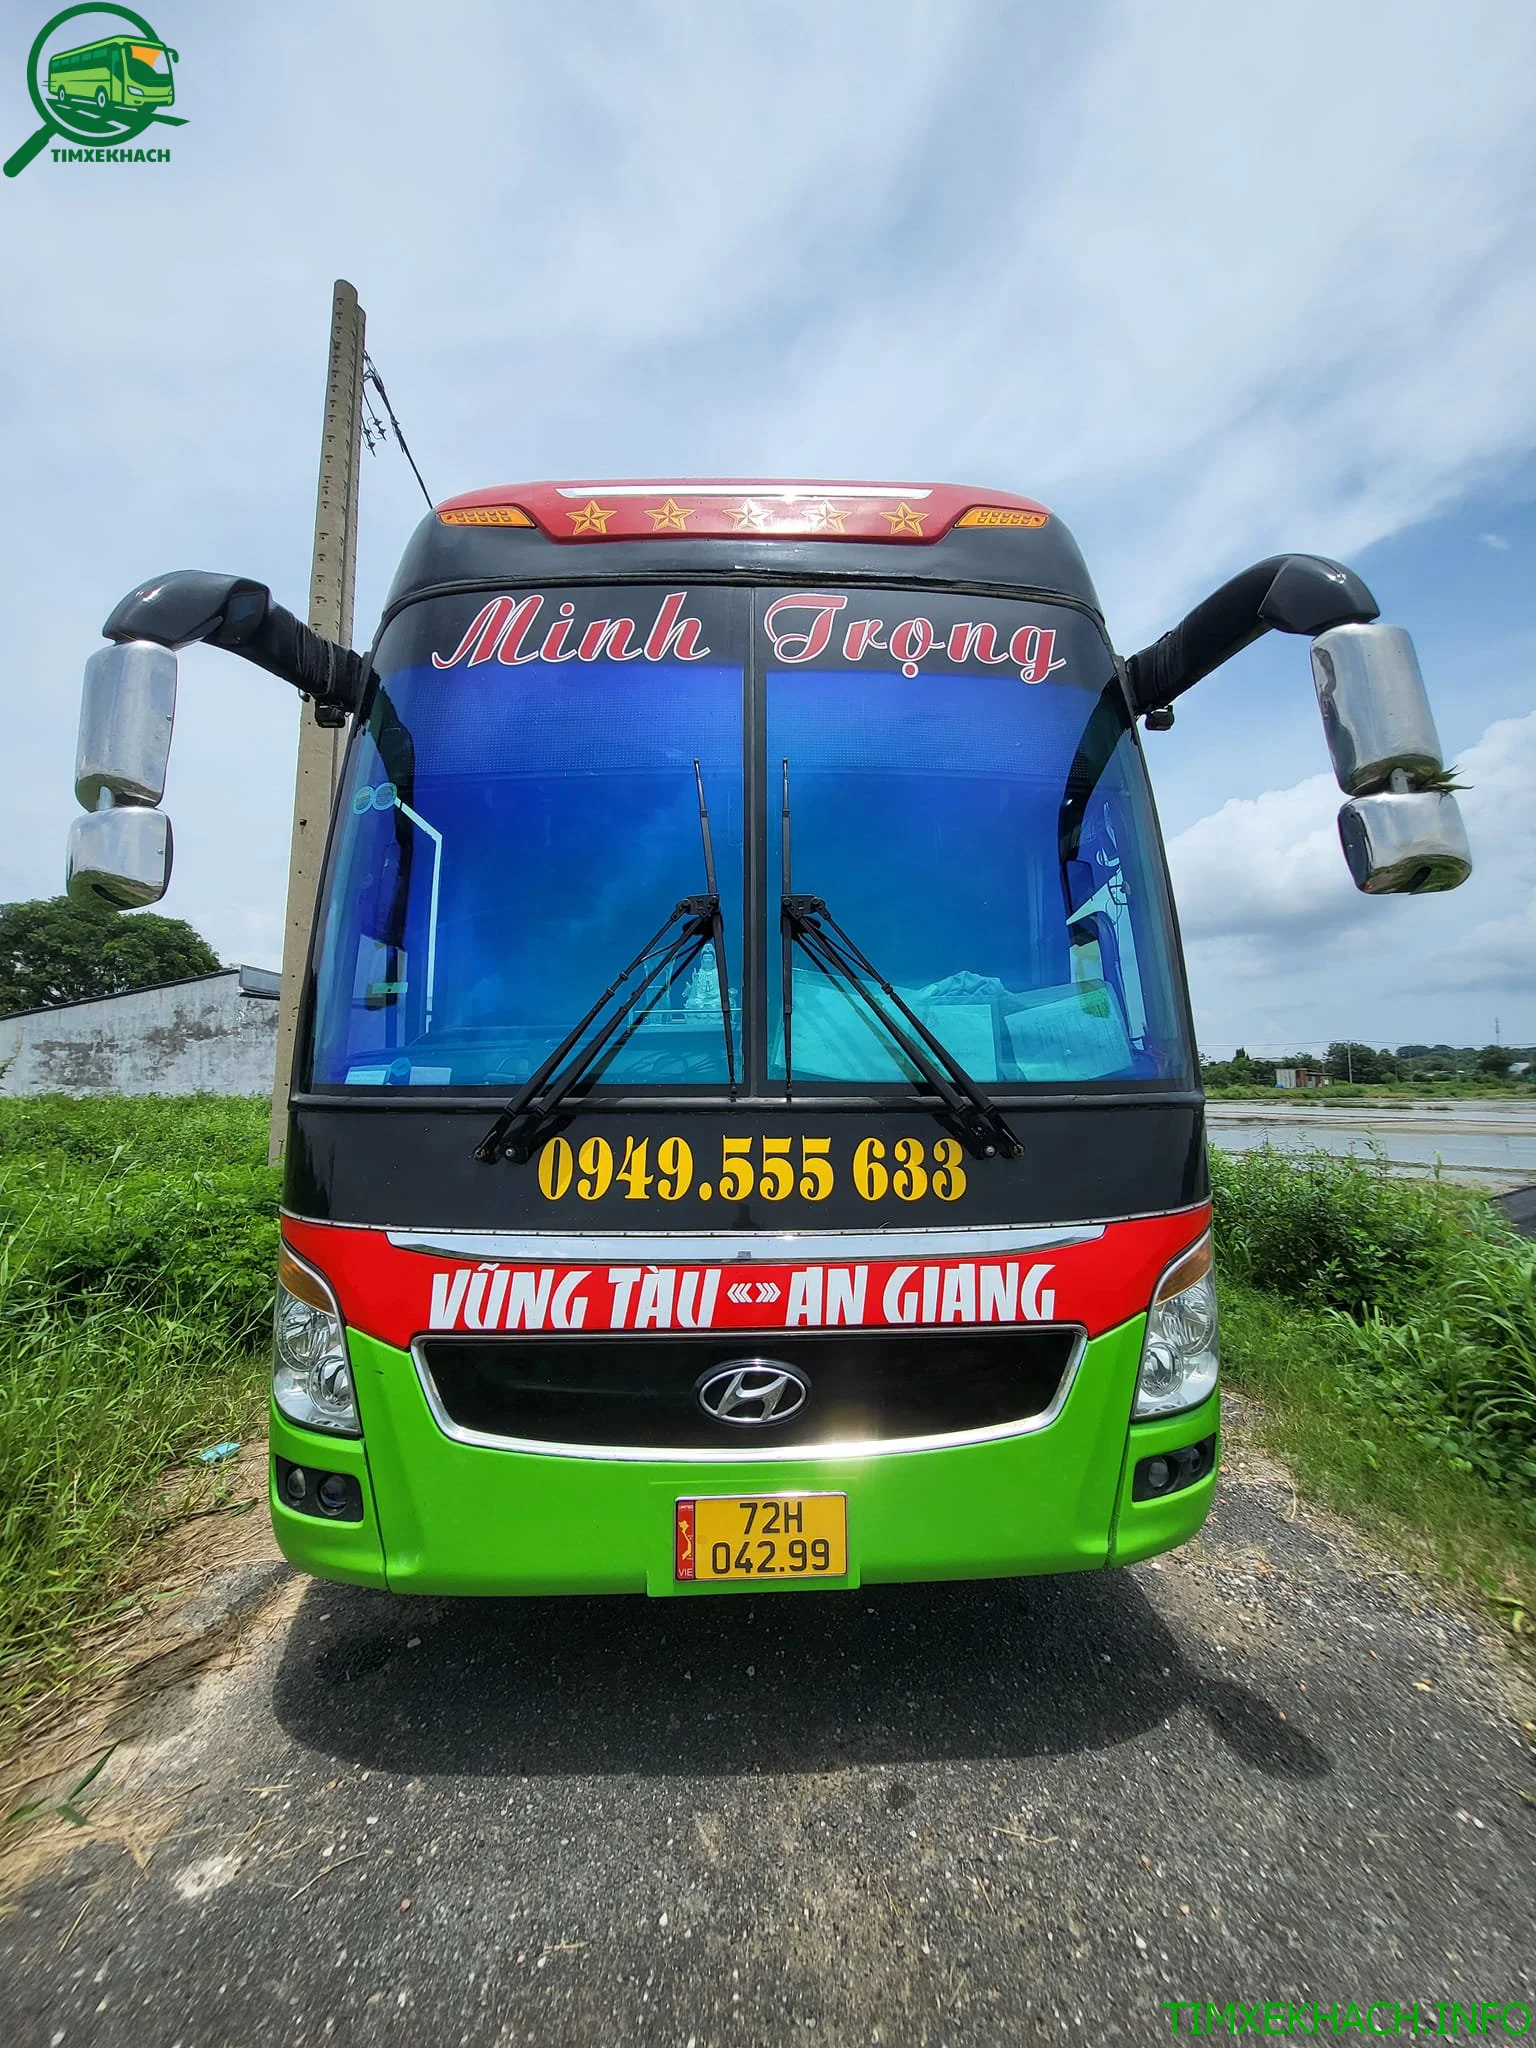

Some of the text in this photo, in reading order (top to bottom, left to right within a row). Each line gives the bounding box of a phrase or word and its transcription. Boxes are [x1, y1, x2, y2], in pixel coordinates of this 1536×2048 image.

[431, 591, 1068, 686] Minh Trọng
[536, 1134, 967, 1202] 0949.555 633
[428, 1262, 1056, 1331] VŨNG TÀU AN GIANG
[739, 1501, 803, 1535] 72H
[678, 1567, 693, 1578] VIE
[711, 1538, 830, 1575] 042.99
